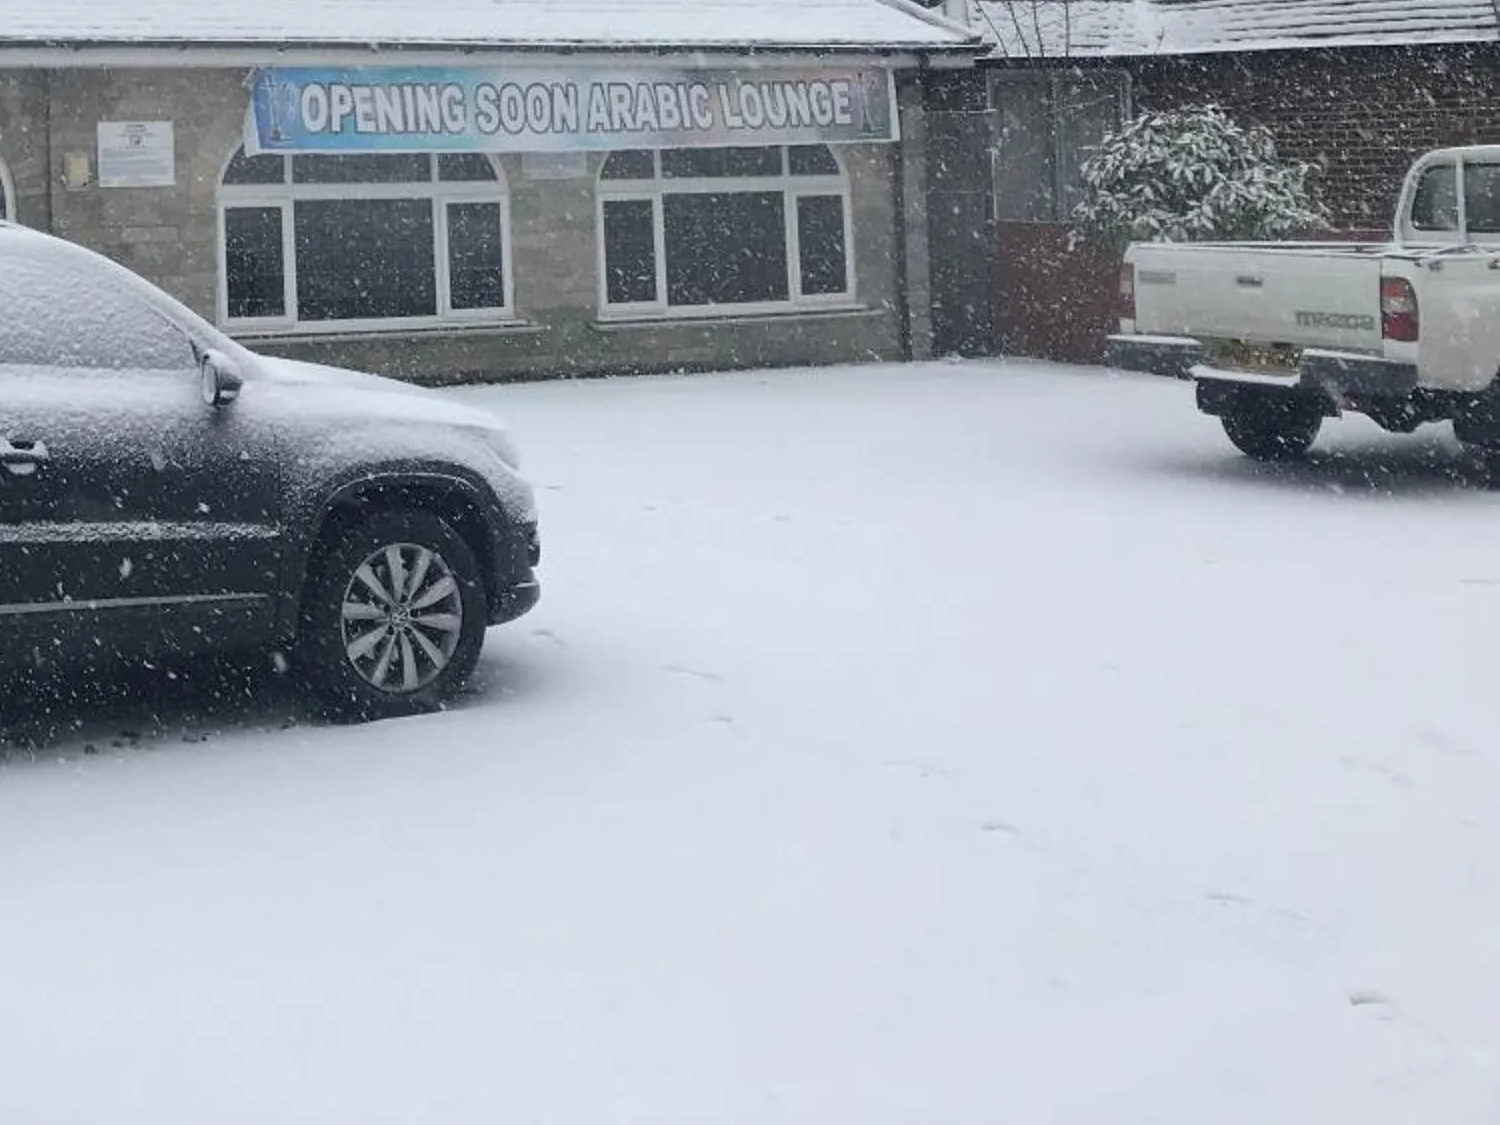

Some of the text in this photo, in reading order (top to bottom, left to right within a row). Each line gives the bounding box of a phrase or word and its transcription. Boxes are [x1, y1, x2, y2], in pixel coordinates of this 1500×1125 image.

[300, 80, 852, 134] OPENING SOON ARABIC LOUNGE
